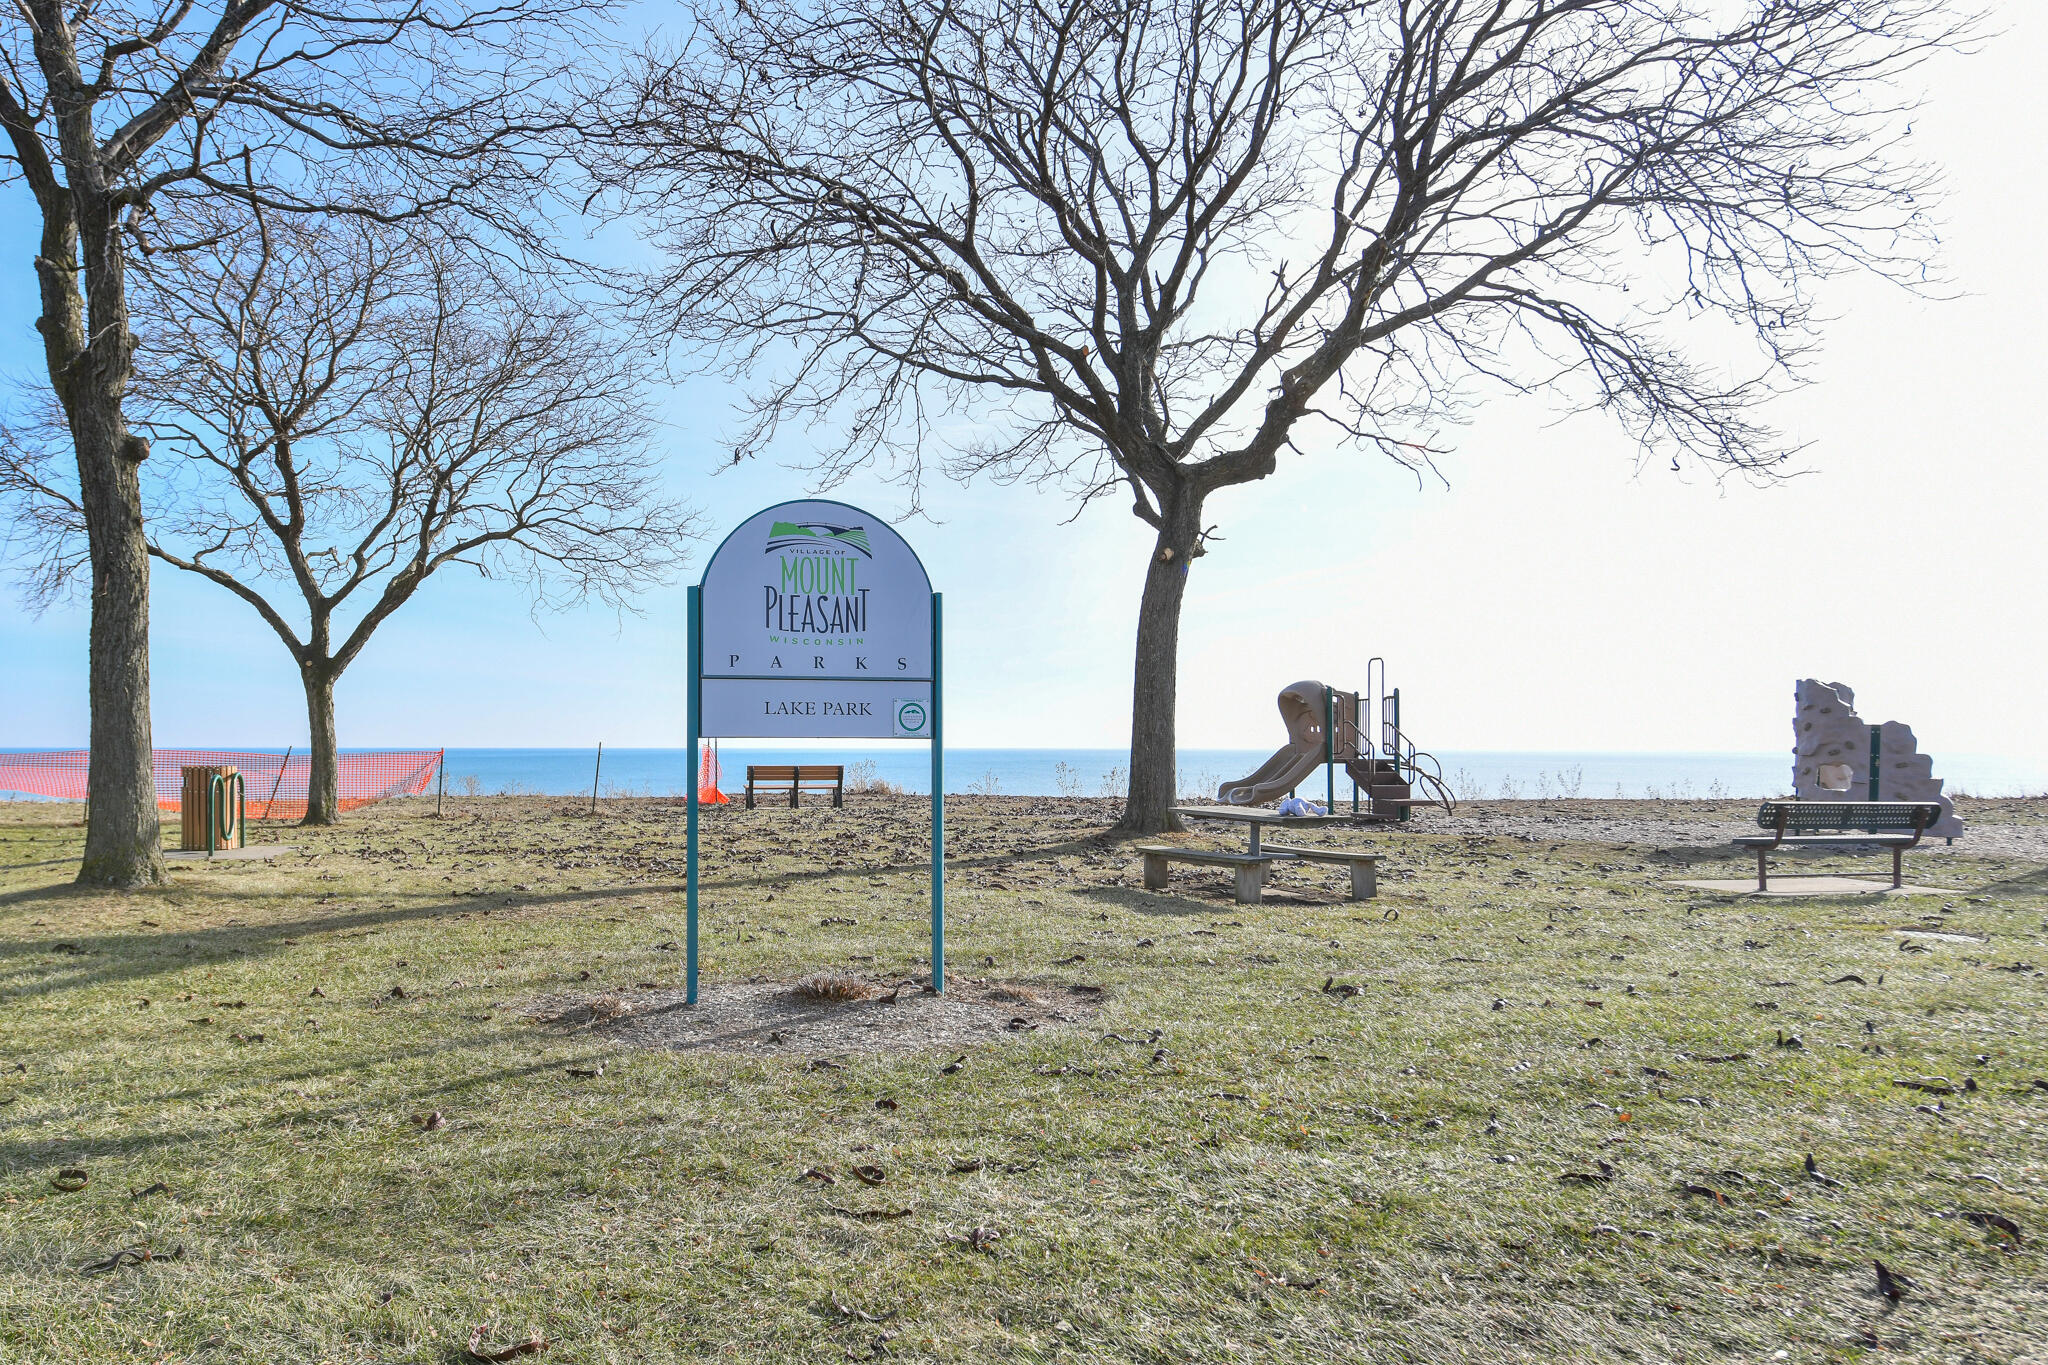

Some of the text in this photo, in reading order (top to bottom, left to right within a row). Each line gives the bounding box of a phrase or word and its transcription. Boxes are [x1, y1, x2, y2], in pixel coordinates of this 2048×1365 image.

[780, 556, 859, 596] MOUNT
[764, 585, 870, 634] PLEASANT
[769, 635, 864, 646] WISCONSIN
[764, 702, 873, 716] LAKE PARK
